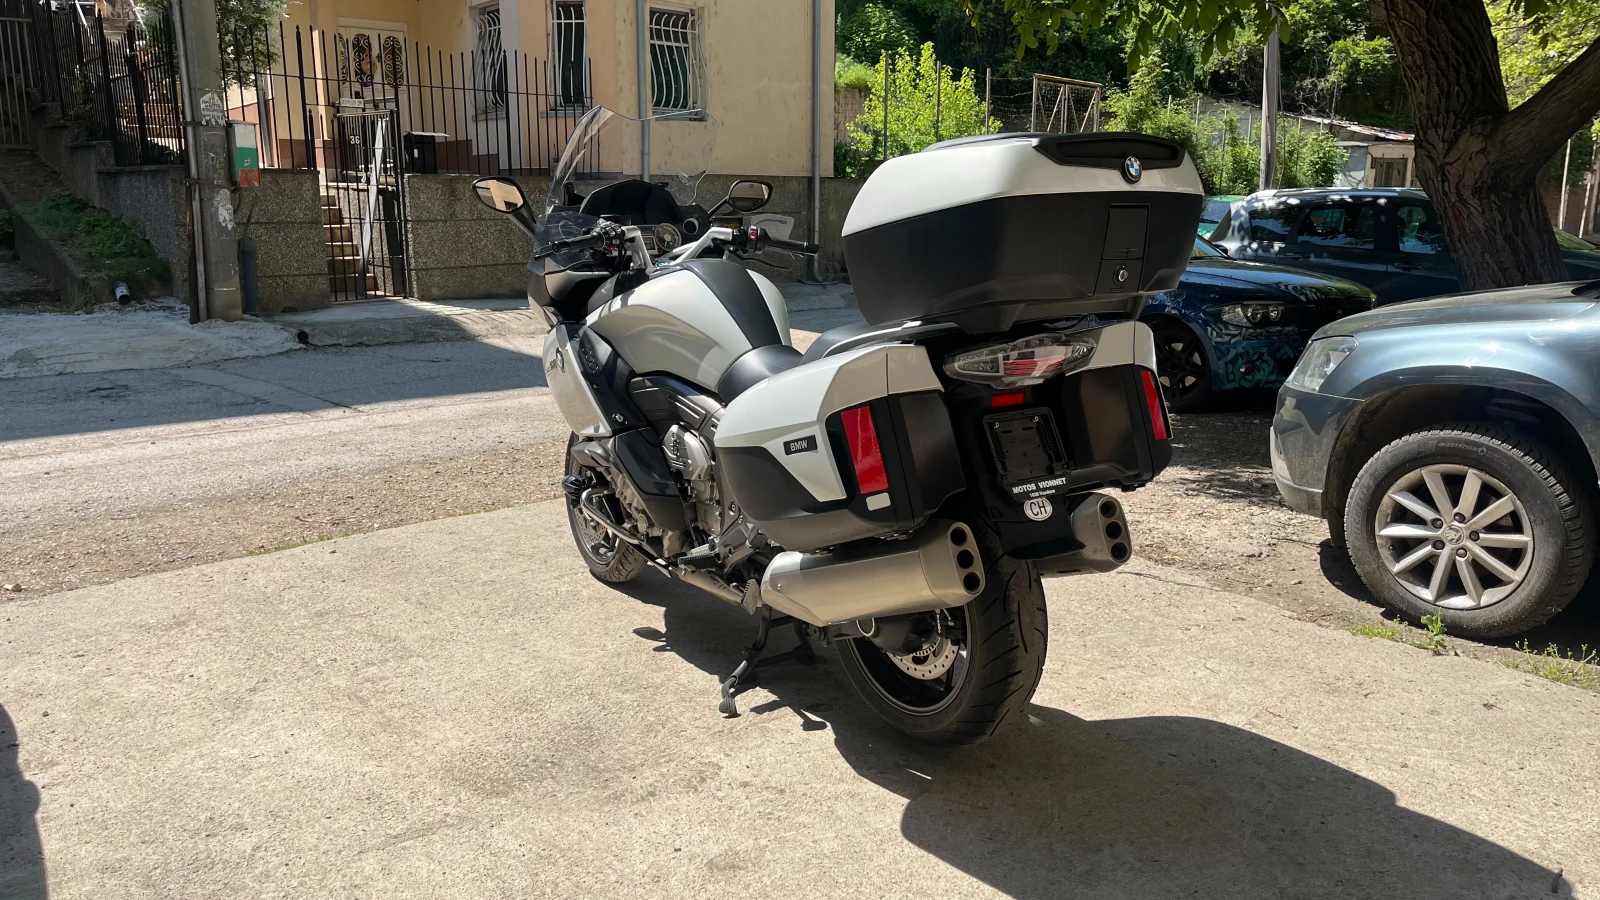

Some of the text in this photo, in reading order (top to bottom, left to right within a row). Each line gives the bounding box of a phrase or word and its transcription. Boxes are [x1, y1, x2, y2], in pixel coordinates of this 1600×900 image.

[350, 135, 360, 144] 36
[790, 439, 807, 451] BMW
[1445, 442, 1478, 452] ROTATION
[1012, 483, 1036, 494] MOTOS
[1038, 477, 1066, 488] VIONNET
[1030, 500, 1047, 516] CH
